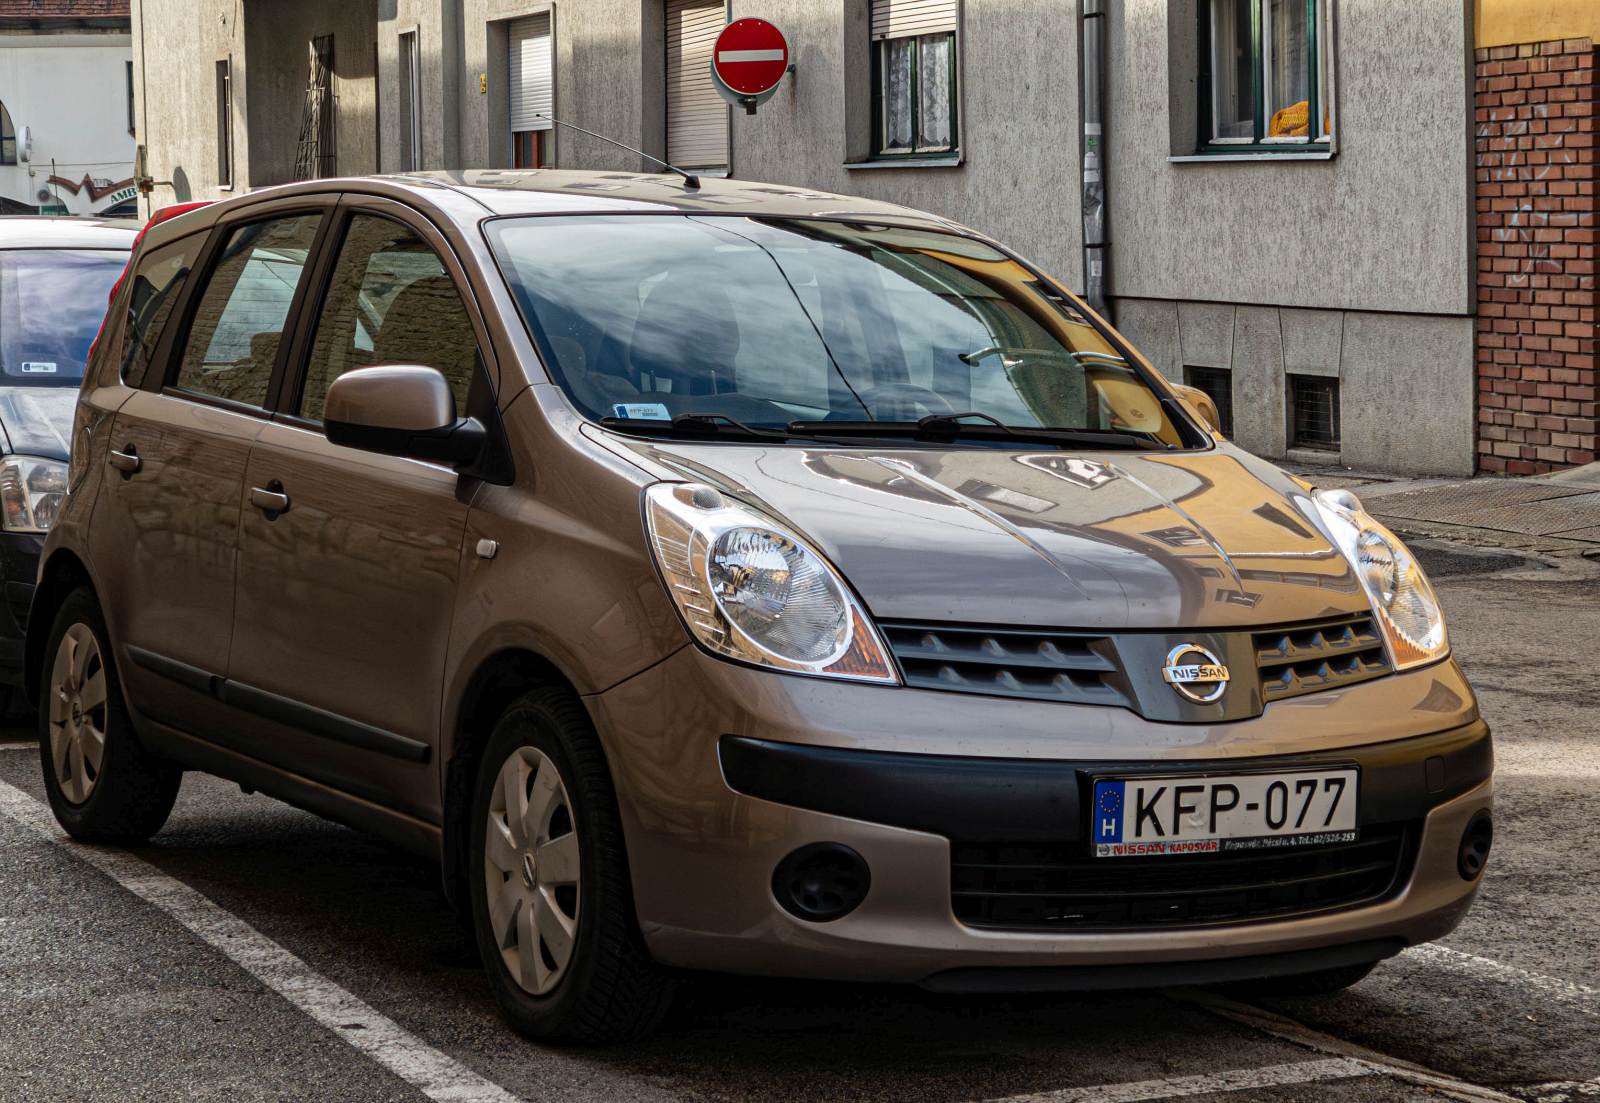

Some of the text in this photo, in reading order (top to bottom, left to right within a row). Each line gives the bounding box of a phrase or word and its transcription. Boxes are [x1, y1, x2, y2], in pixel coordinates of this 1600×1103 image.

[1172, 668, 1226, 679] NISSAN
[1135, 777, 1346, 837] KFP-077
[1102, 818, 1115, 837] H
[1113, 844, 1165, 855] NISSAN
